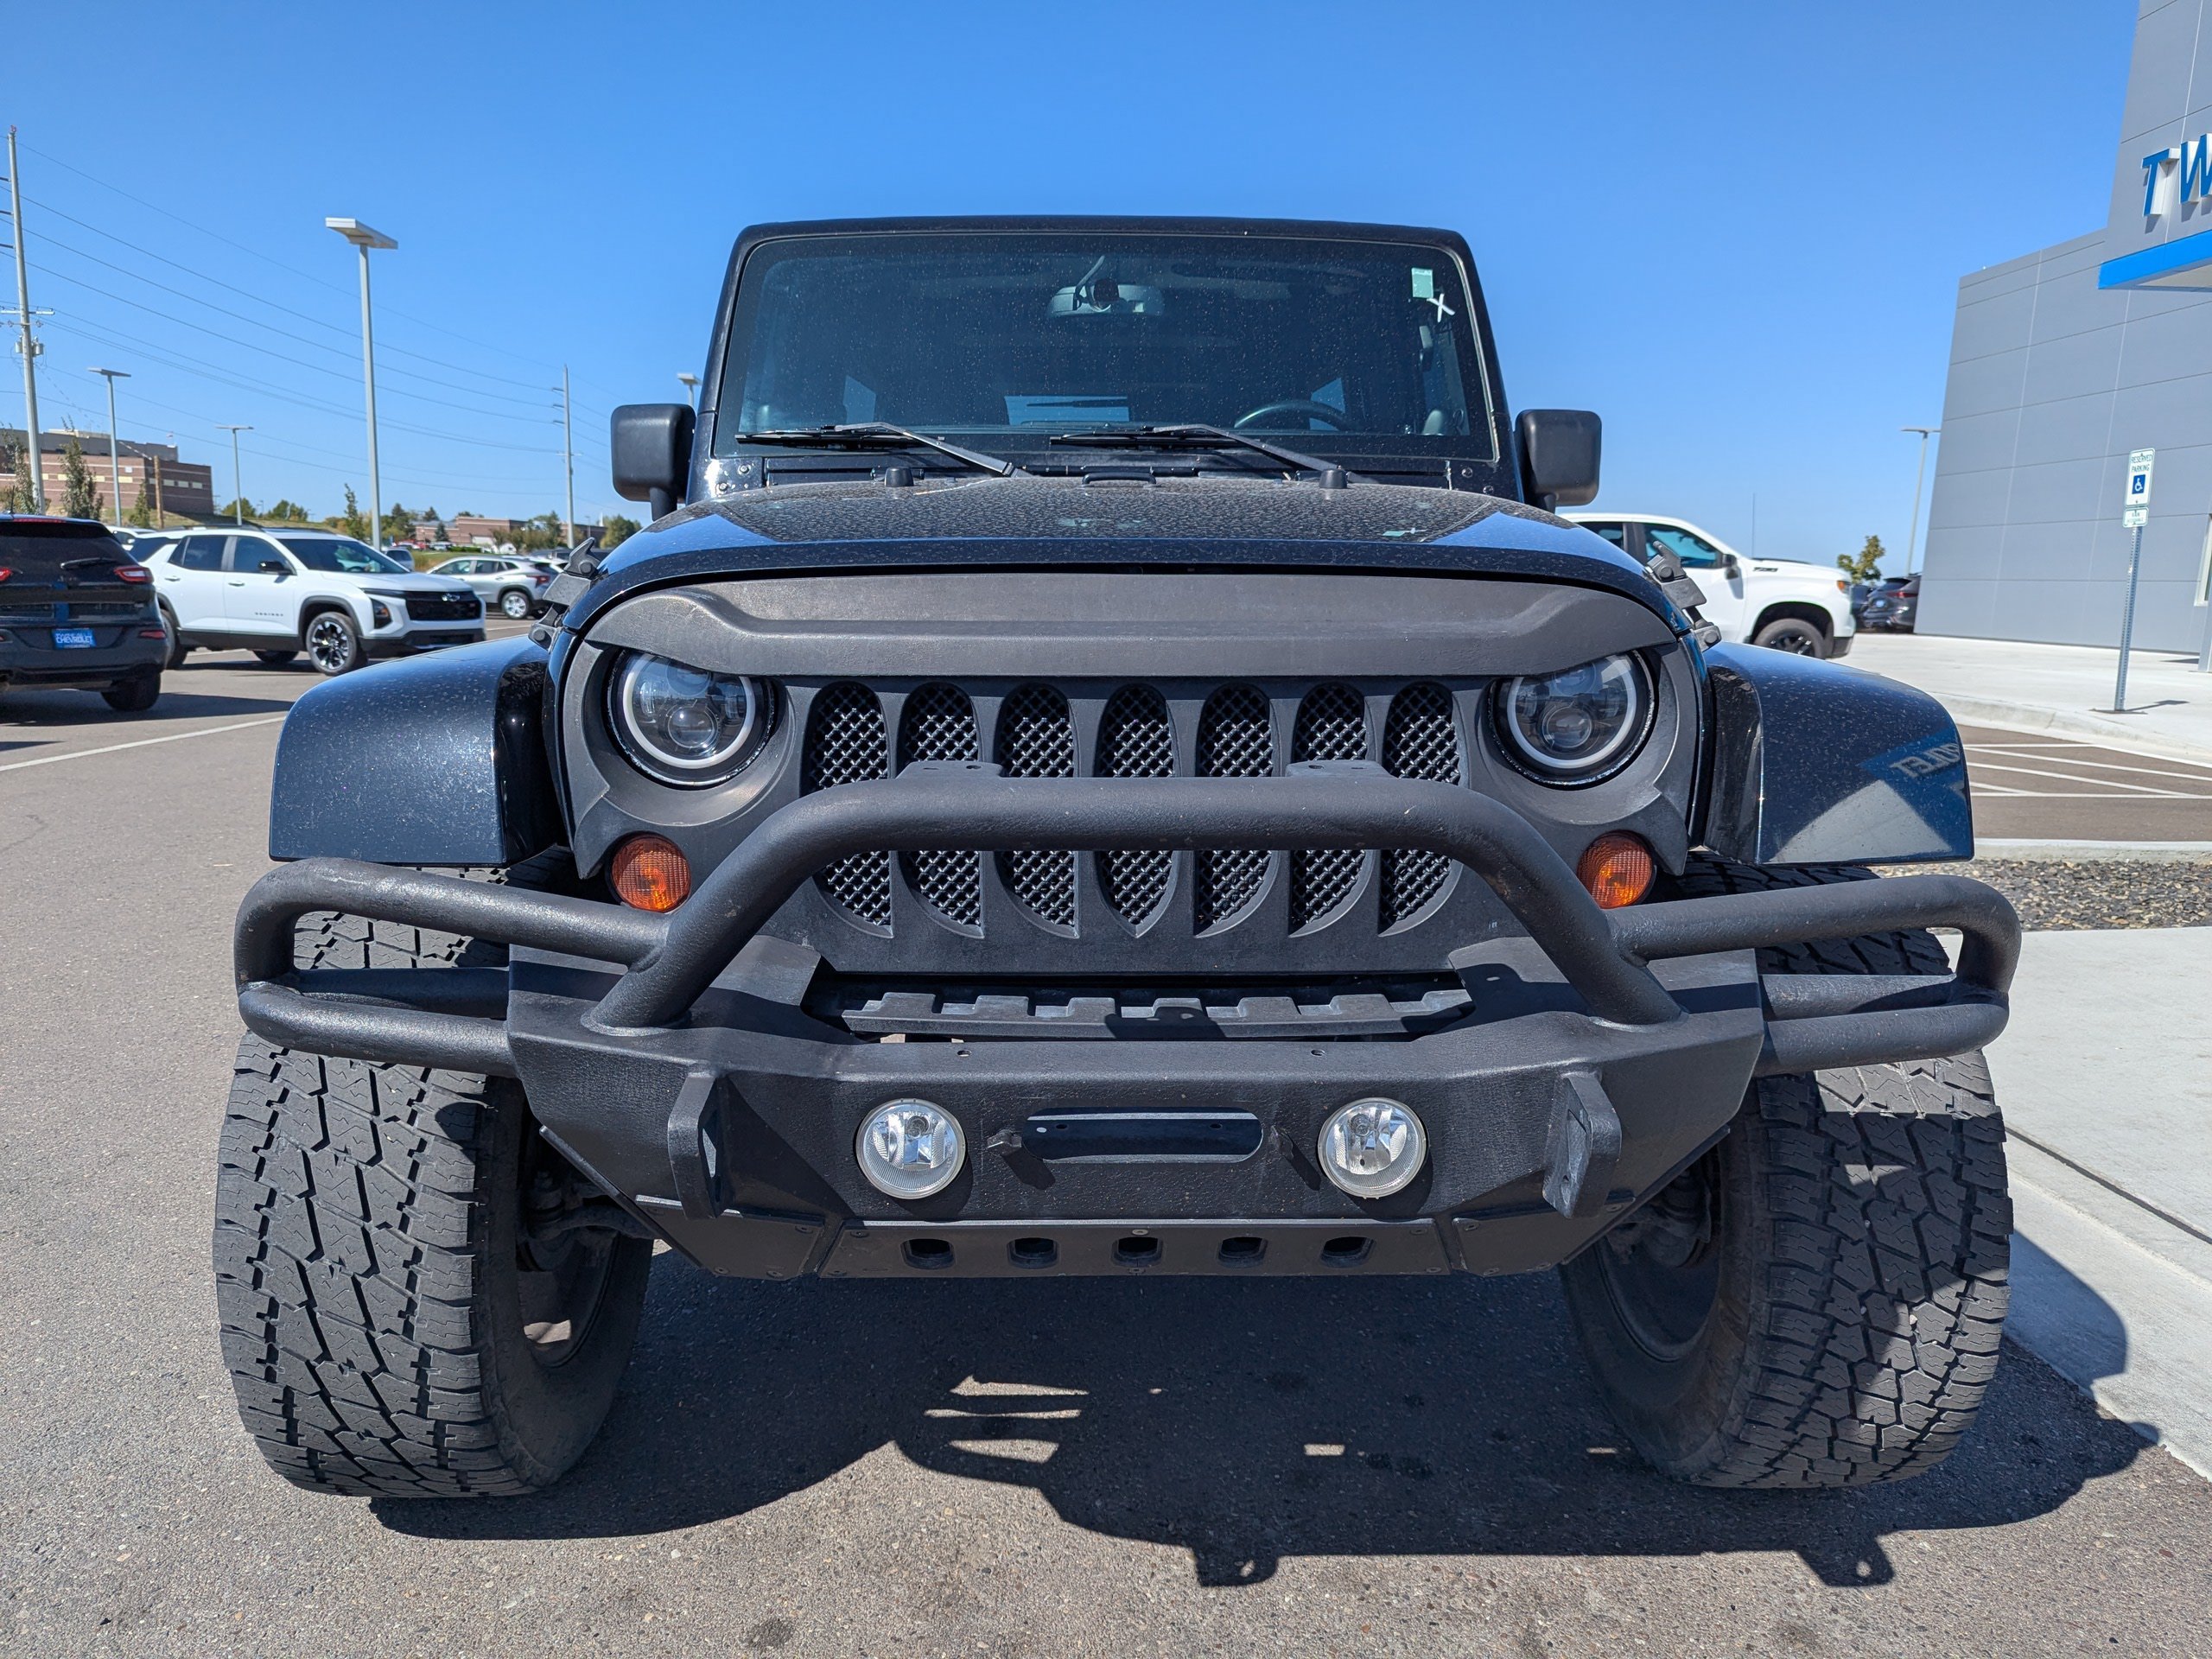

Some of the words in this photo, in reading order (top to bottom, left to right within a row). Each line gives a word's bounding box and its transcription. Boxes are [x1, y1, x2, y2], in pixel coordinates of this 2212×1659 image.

[2131, 454, 2152, 463] RESERVED
[2131, 464, 2150, 473] PARKING
[55, 635, 92, 645] CHEVROLET
